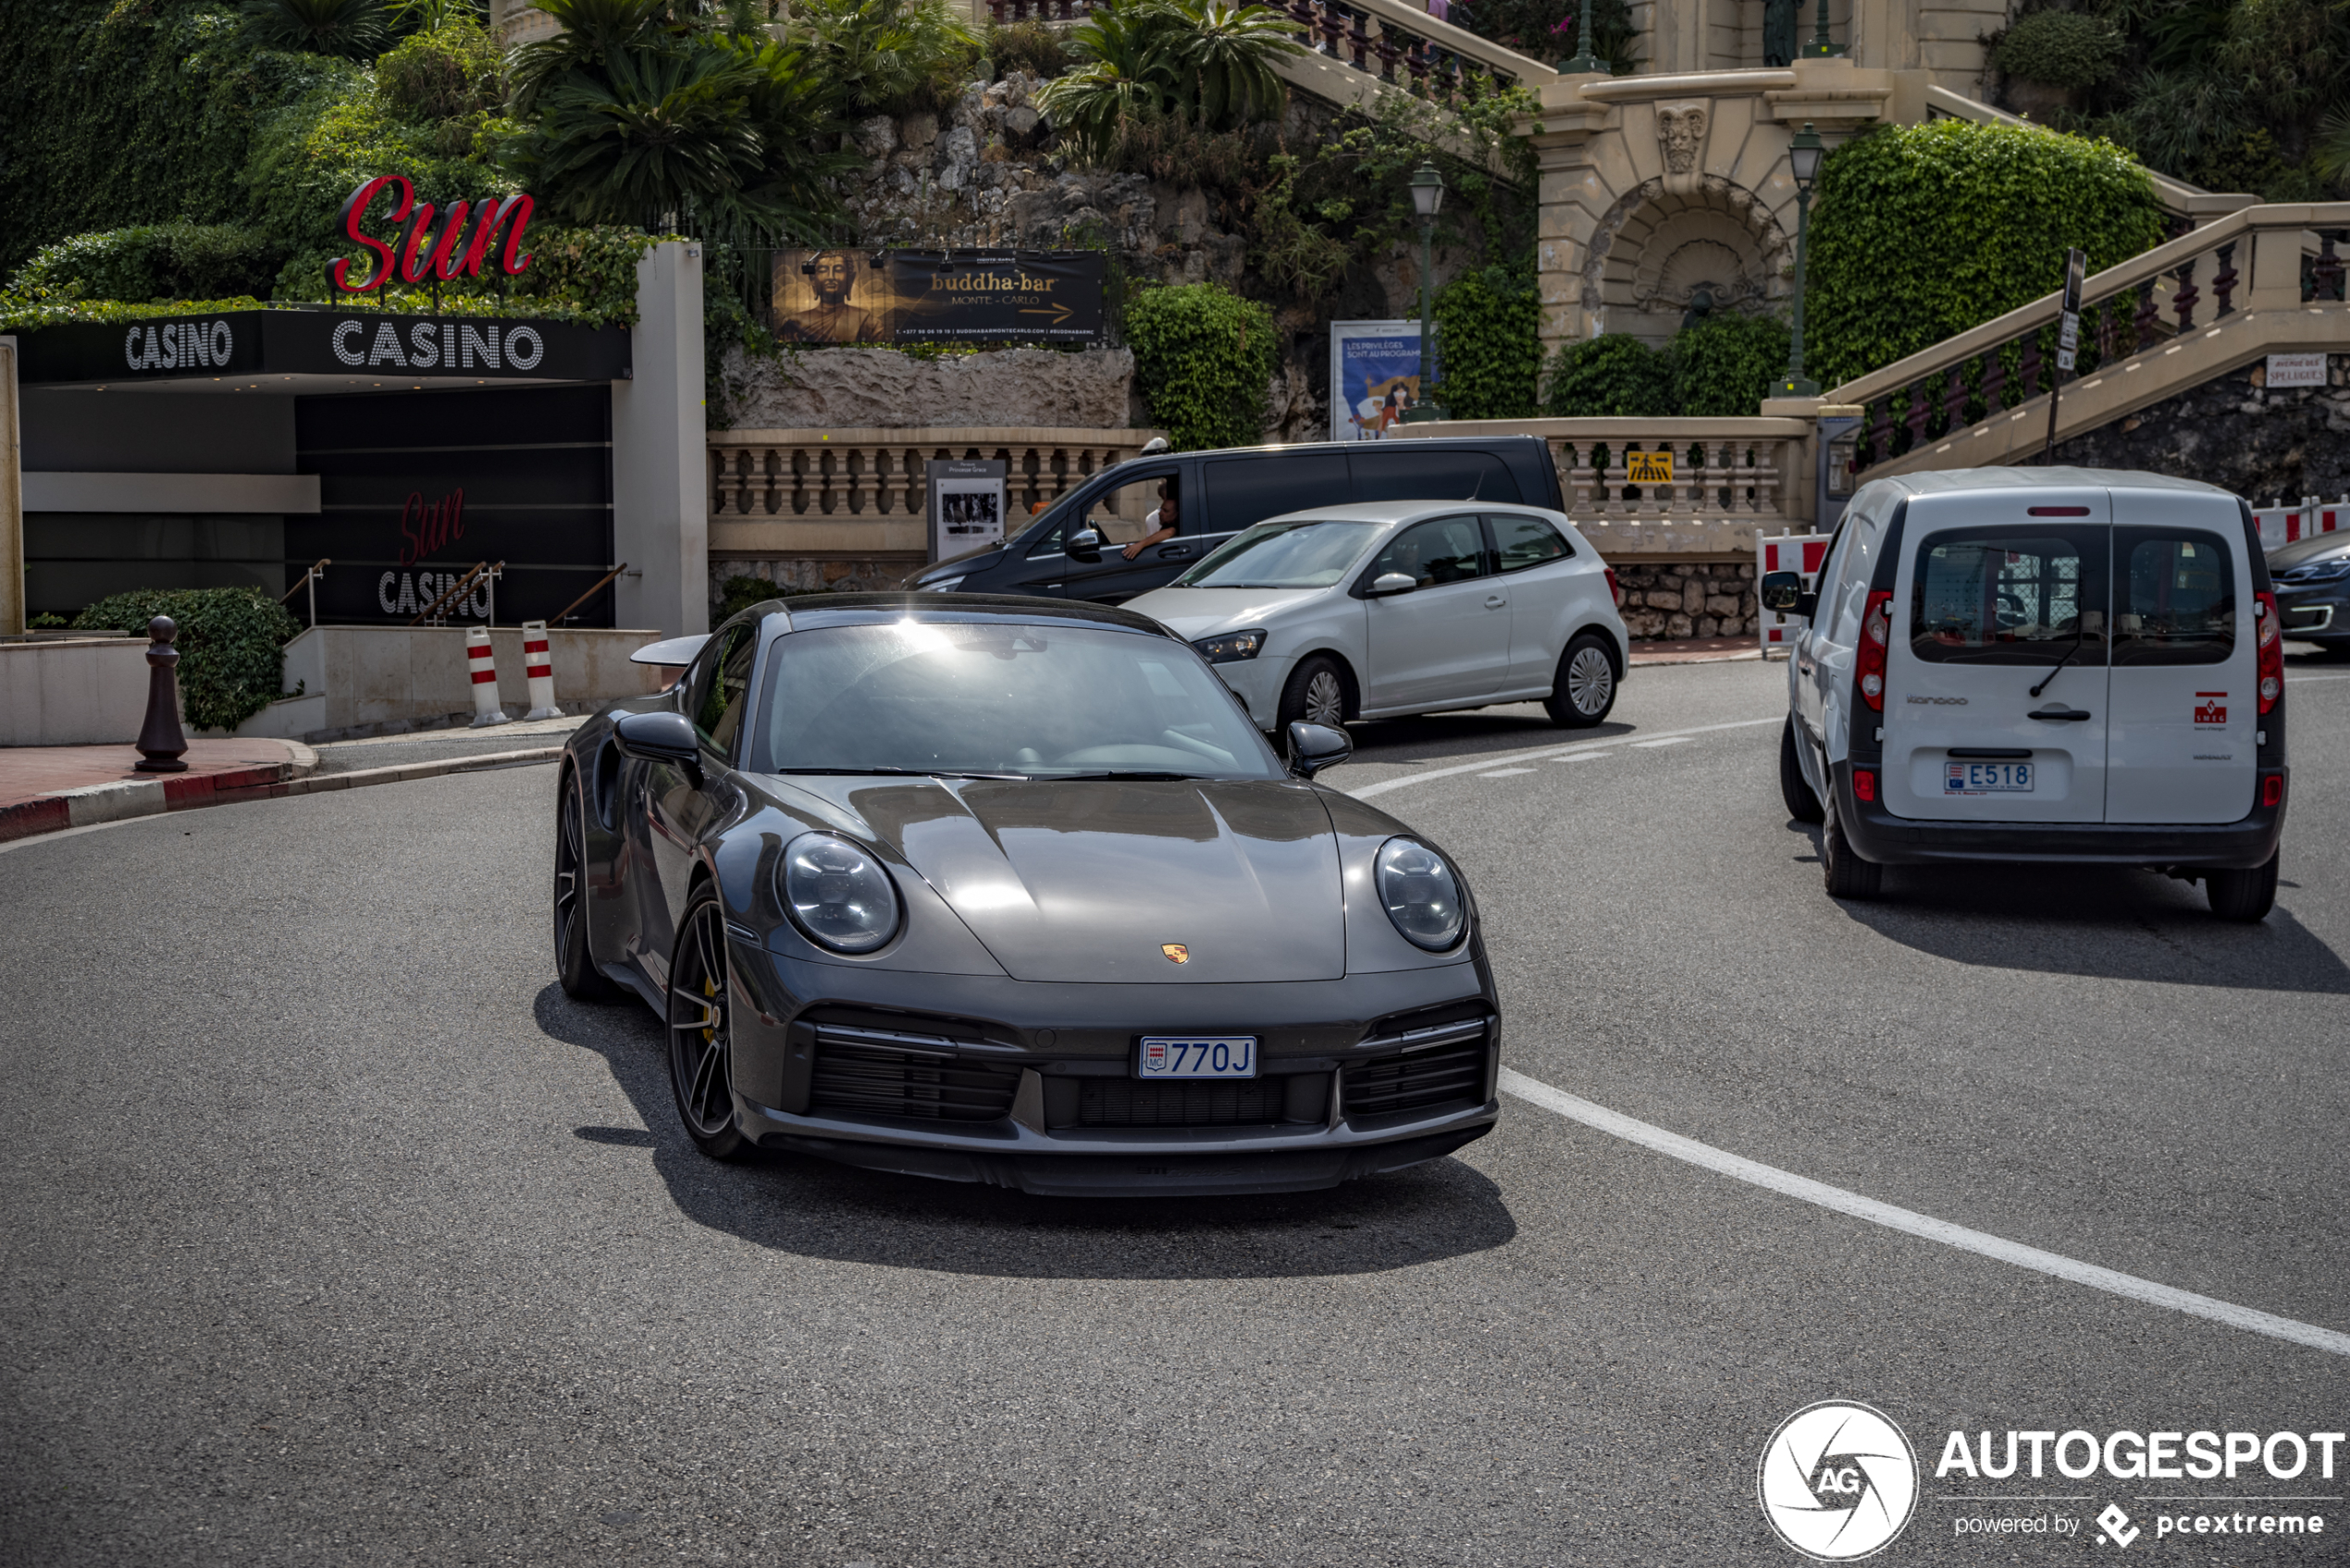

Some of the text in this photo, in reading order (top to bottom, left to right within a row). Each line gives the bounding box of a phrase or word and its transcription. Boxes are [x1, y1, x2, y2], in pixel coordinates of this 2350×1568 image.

[326, 175, 535, 292] Sun
[931, 272, 1055, 292] buddha-bar
[952, 296, 993, 305] MONTE
[1002, 296, 1040, 305] CARLO
[126, 320, 233, 371] CASINO
[332, 319, 544, 370] CASINO
[1347, 342, 1361, 351] LES
[400, 488, 464, 567] Sun
[1971, 765, 2028, 784] E518
[1149, 1057, 1163, 1068] MC
[1171, 1043, 1249, 1072] 770J
